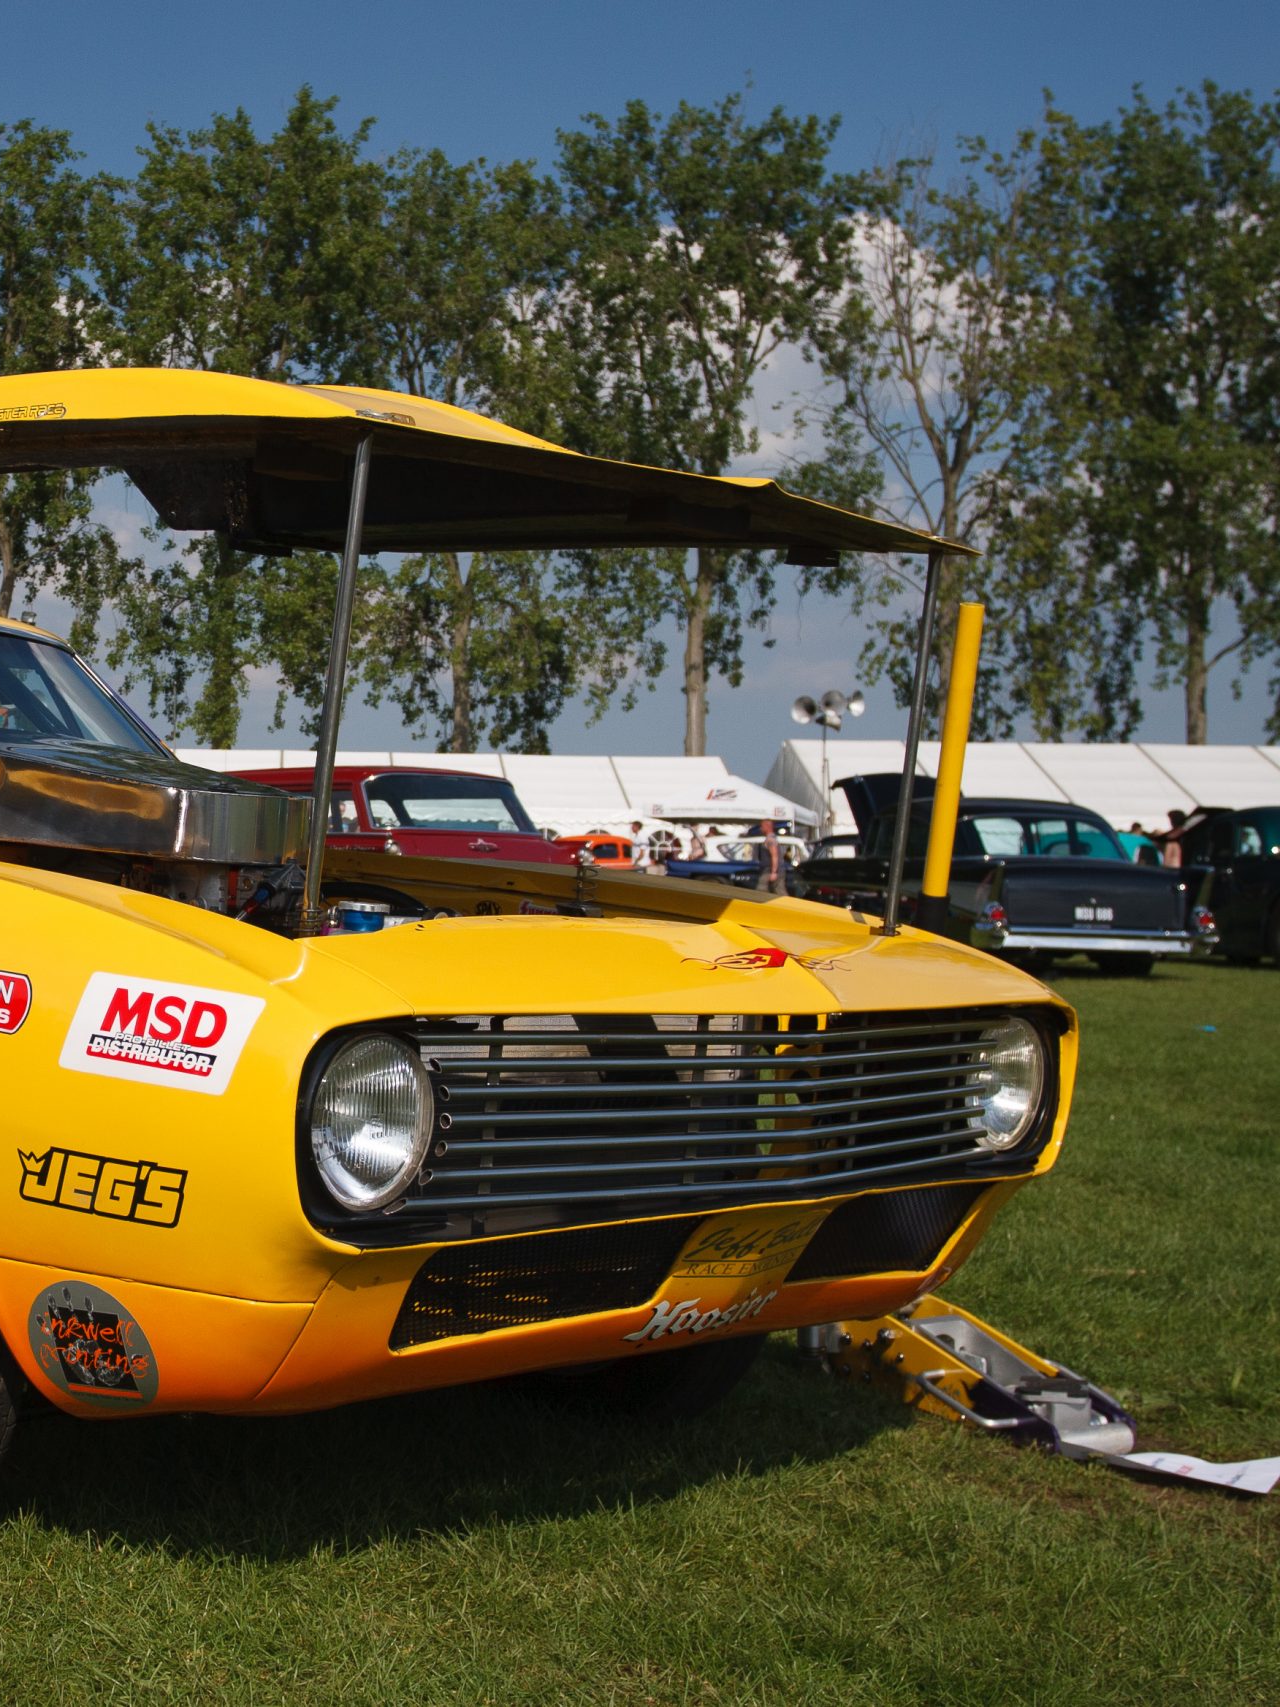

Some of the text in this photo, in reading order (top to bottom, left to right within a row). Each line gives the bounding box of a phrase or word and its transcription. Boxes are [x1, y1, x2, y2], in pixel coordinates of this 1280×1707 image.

[100, 987, 228, 1049] MSD
[90, 1036, 214, 1073] DISTRIBUTOR
[114, 1031, 192, 1051] PRO-BILLET
[18, 1146, 189, 1229] JEG'S
[686, 1262, 732, 1276] RACE
[623, 1288, 777, 1342] Hoosier
